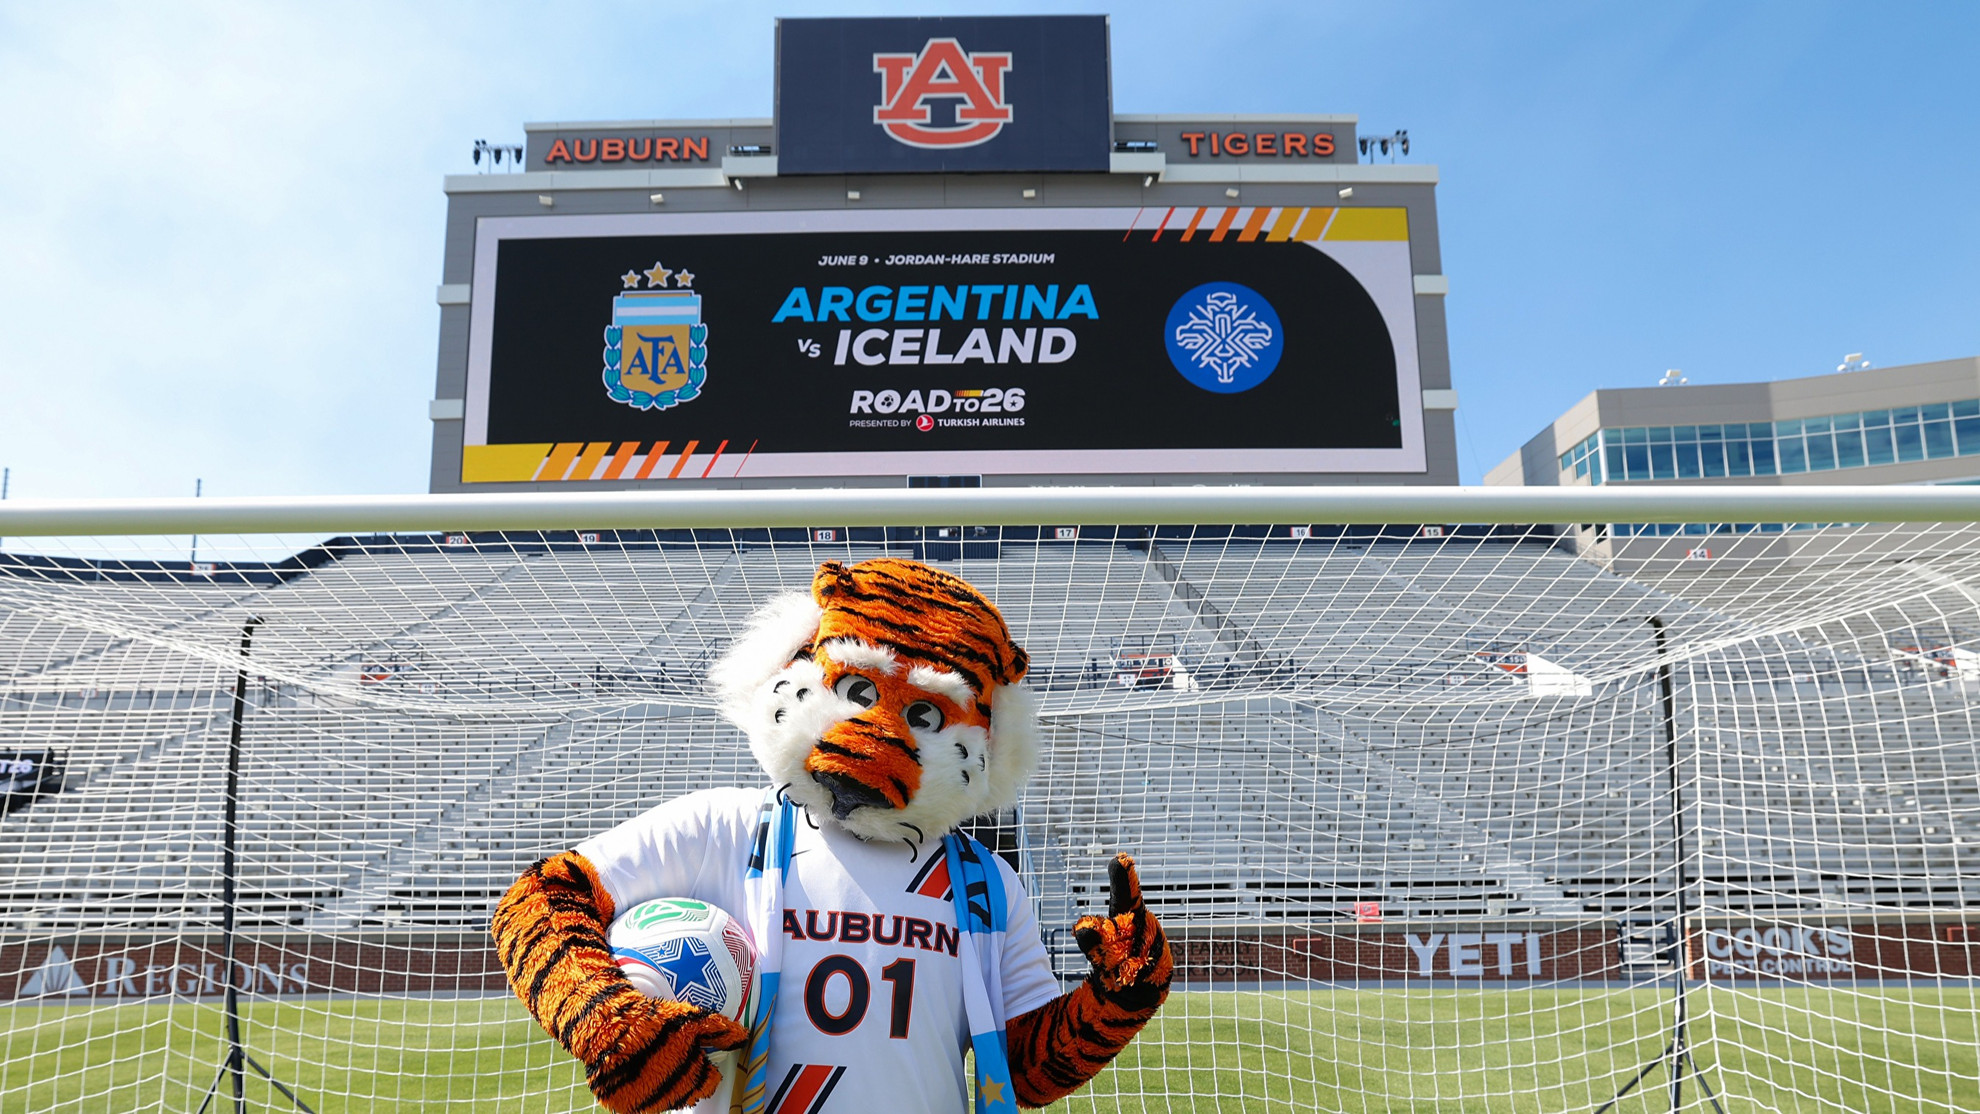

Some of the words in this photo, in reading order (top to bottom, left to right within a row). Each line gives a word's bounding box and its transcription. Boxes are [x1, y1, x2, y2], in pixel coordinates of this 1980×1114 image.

[545, 136, 709, 164] AUBURN
[1181, 132, 1336, 157] TIGERS
[818, 255, 857, 266] JUNE
[858, 255, 869, 266] 9
[885, 253, 990, 266] JORDAN-HARE
[992, 253, 1056, 264] STADIUM
[771, 283, 1100, 323] ARGENTINA
[833, 327, 1077, 367] ICELAND
[624, 332, 686, 385] AFA
[849, 388, 952, 414] ROAD
[953, 398, 980, 413] TO
[980, 387, 1026, 413] 26
[849, 418, 900, 428] PRESENTED
[901, 418, 912, 428] BY
[937, 417, 980, 428] TURKISH
[981, 417, 1026, 427] AIRLINES
[450, 536, 463, 545] 20
[584, 534, 596, 543] 19
[818, 531, 832, 541] 18
[1059, 528, 1072, 538] 17
[1296, 528, 1306, 537] 16
[1427, 528, 1439, 537] 15
[783, 908, 960, 957] AUBURN
[1707, 925, 1851, 958] COOK'S
[1191, 939, 1252, 955] FAMILY
[1402, 932, 1542, 976] YETI
[1203, 960, 1263, 977] ROOM
[1710, 959, 1757, 975] PEST
[1761, 957, 1852, 973] CONTROL
[803, 953, 916, 1039] 01
